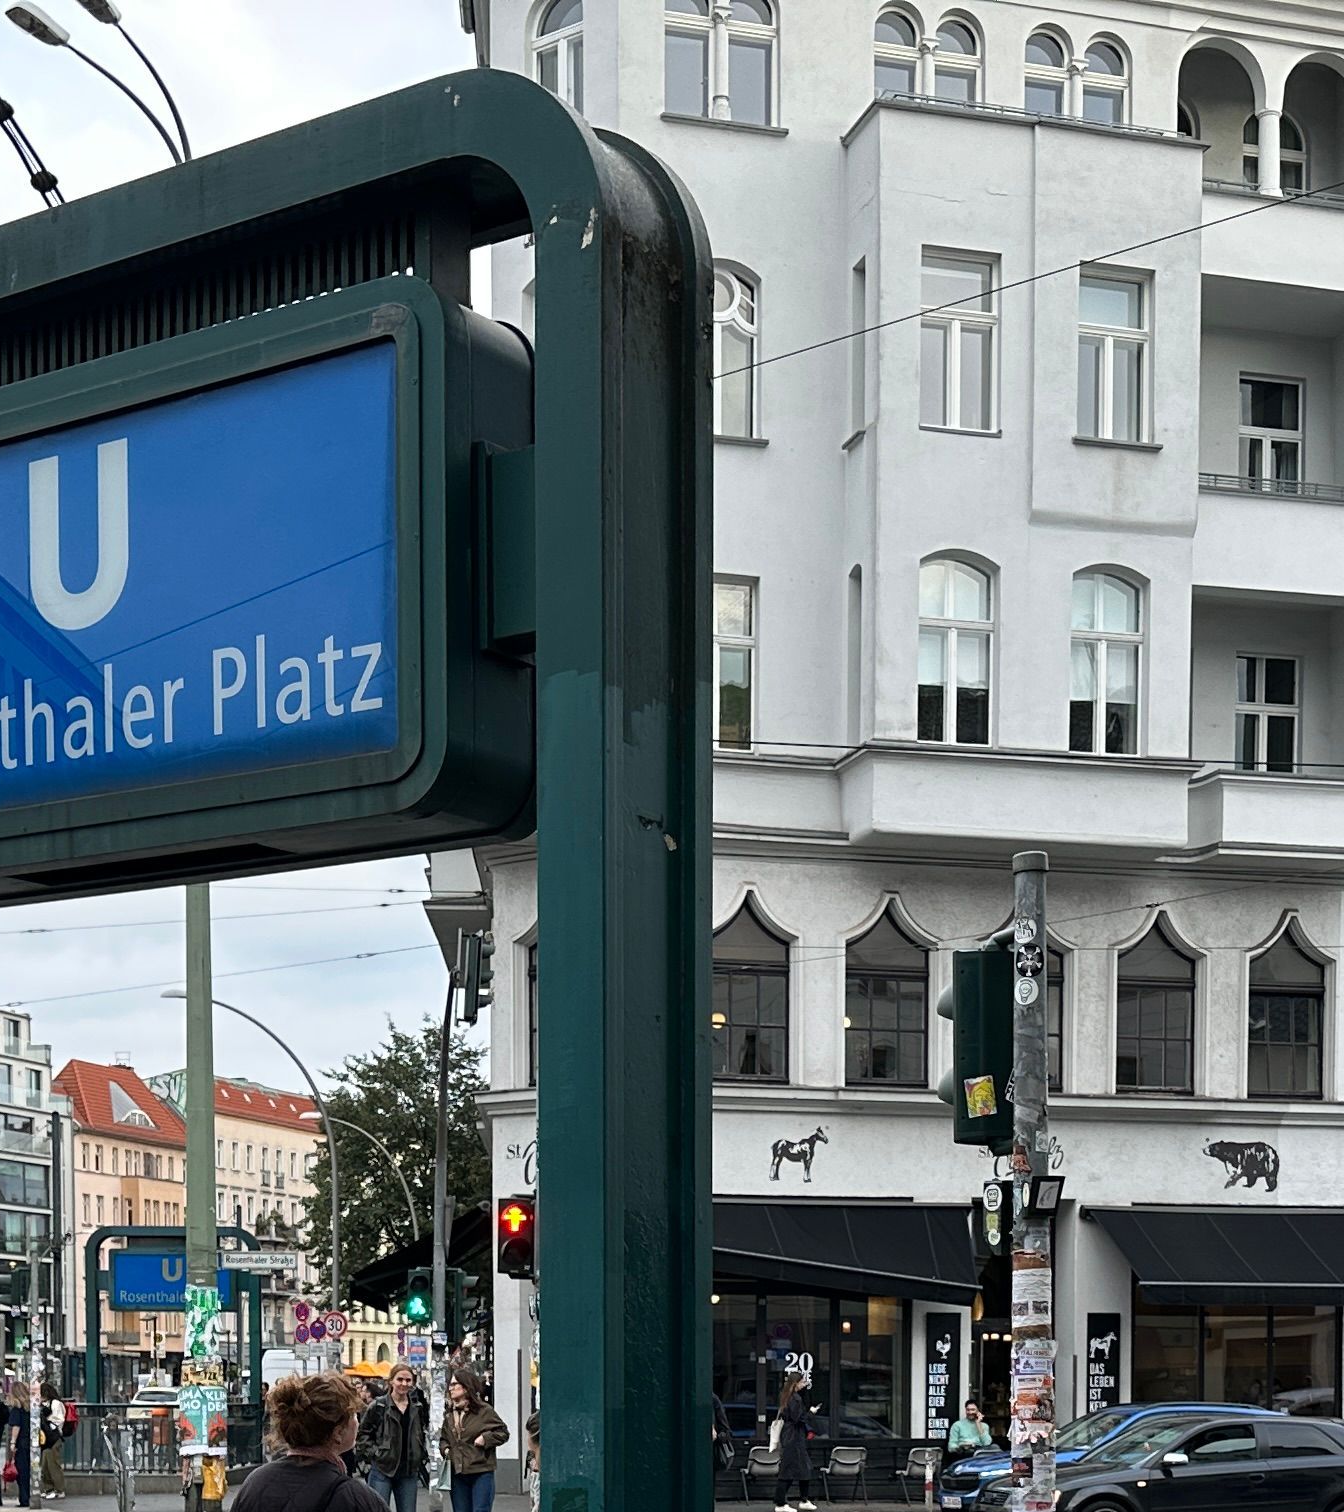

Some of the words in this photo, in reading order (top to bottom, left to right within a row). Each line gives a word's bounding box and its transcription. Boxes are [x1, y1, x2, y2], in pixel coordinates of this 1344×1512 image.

[29, 438, 129, 631] U
[212, 634, 384, 736] Platz
[162, 1258, 183, 1281] U
[120, 1290, 186, 1305] Rosenthale
[328, 1319, 342, 1332] 30
[784, 1352, 814, 1373] 20
[1089, 1363, 1105, 1375] DAS
[1089, 1388, 1102, 1400] IST
